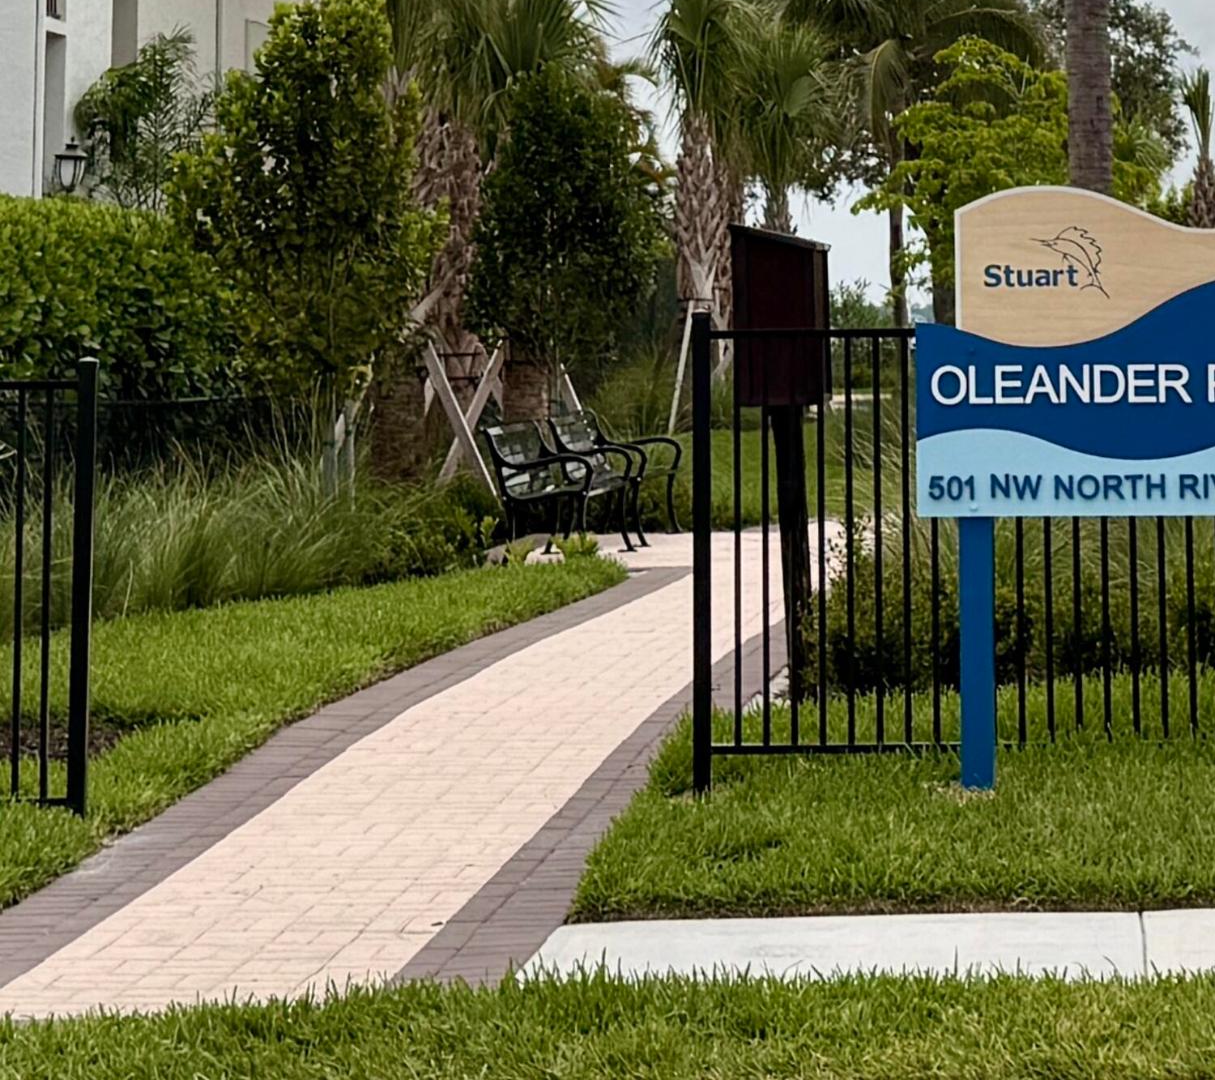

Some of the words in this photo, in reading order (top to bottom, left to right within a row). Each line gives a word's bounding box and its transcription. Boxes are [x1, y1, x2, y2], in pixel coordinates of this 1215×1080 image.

[983, 264, 1078, 288] Stuart
[930, 364, 1192, 405] OLEANDER
[928, 475, 976, 501] 501
[990, 474, 1042, 500] NW
[1054, 474, 1167, 500] NORTH
